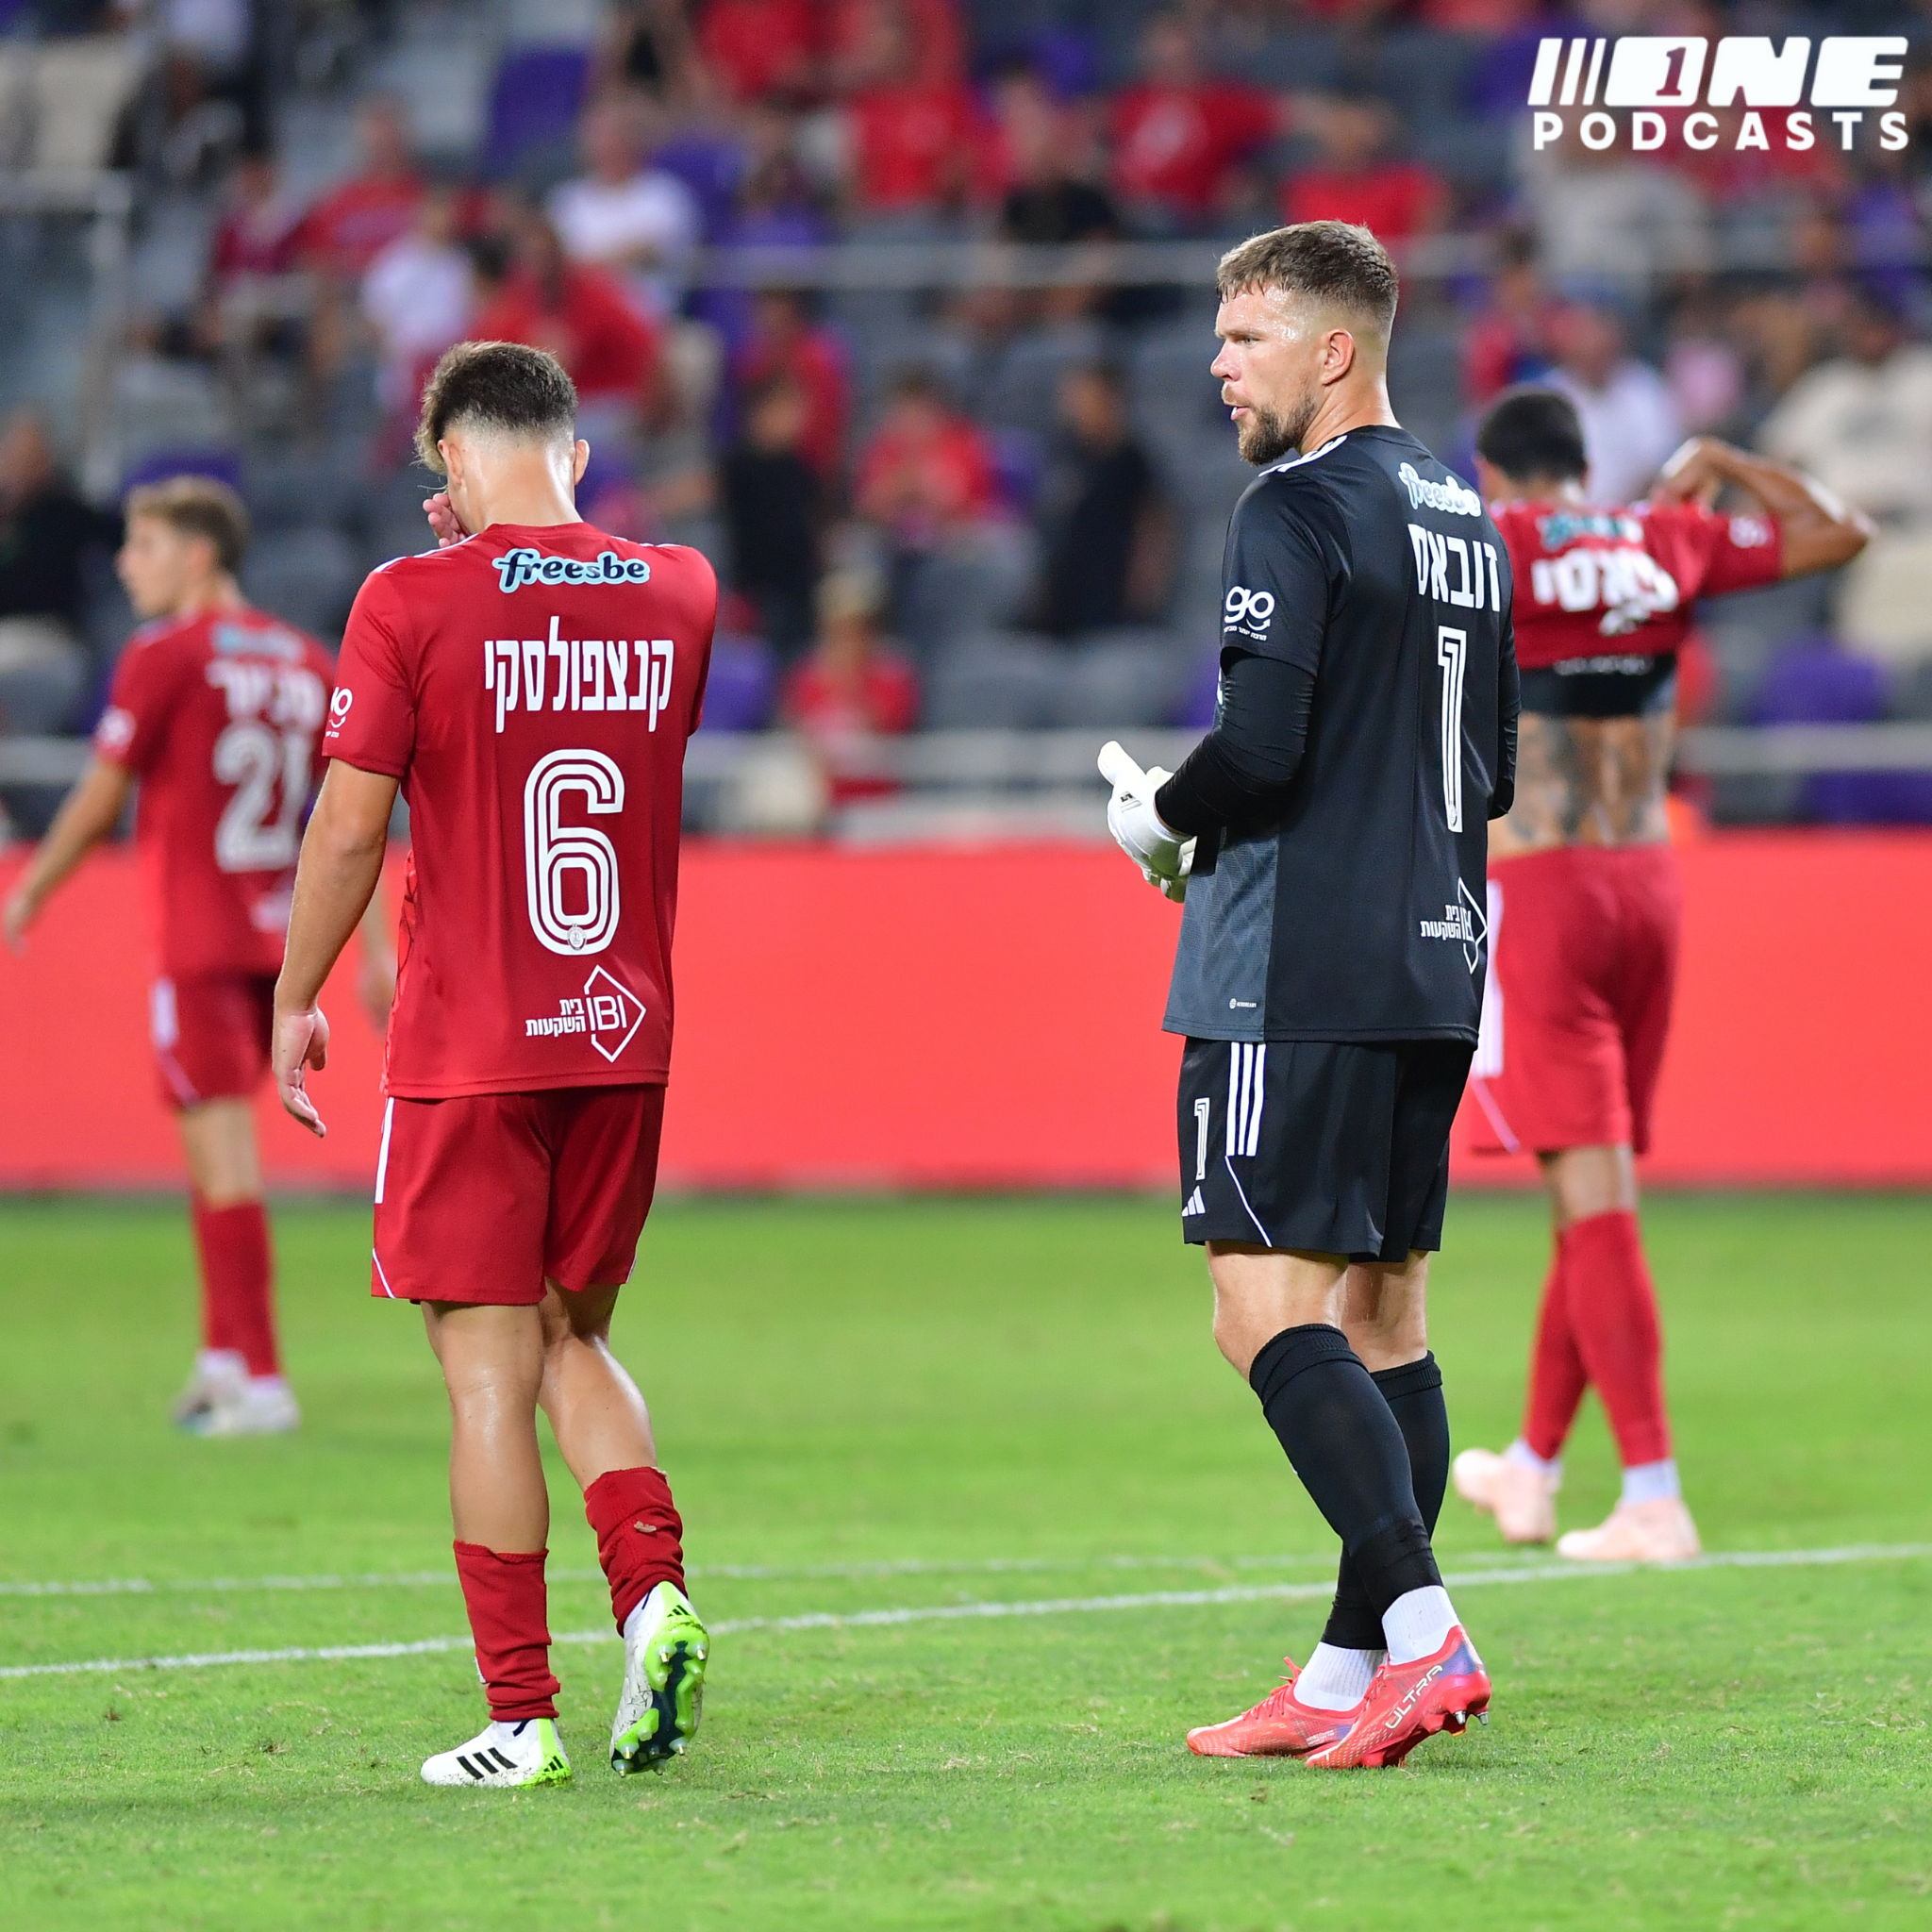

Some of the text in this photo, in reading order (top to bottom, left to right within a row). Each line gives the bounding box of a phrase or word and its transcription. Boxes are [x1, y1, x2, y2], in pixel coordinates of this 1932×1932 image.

[493, 548, 650, 592] freesbe
[1224, 586, 1275, 624] go
[484, 616, 675, 733] קנצפולסקי
[1438, 625, 1467, 833] 1
[212, 719, 314, 874] 21
[524, 749, 625, 956] 6
[1420, 921, 1461, 941] השקעות
[525, 1015, 587, 1038] השקעות
[559, 998, 585, 1016] בית
[586, 994, 627, 1032] IBI
[1194, 1097, 1210, 1180] 1
[1384, 1665, 1443, 1729] ULTRA
